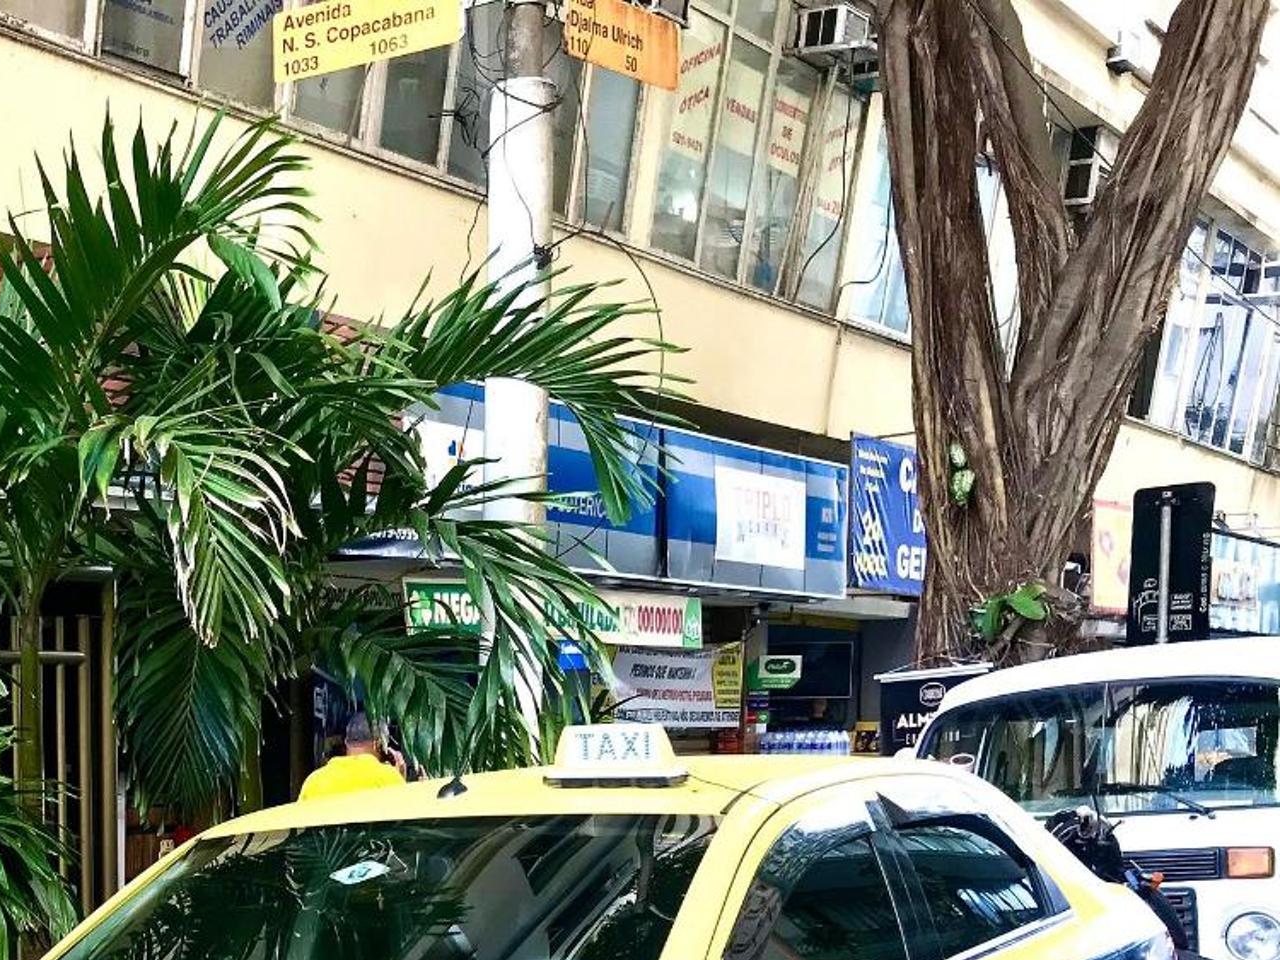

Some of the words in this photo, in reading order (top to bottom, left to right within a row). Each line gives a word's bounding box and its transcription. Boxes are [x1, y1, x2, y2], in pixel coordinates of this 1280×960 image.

[282, 37, 299, 54] N.
[304, 32, 320, 48] S.
[326, 6, 435, 43] Copacabana
[283, 4, 352, 32] Avenida
[570, 9, 608, 38] Djalma
[611, 25, 644, 51] Ulrich
[283, 56, 319, 76] 1033
[369, 34, 409, 56] 1063
[625, 55, 638, 72] 50
[575, 732, 650, 760] TAXI
